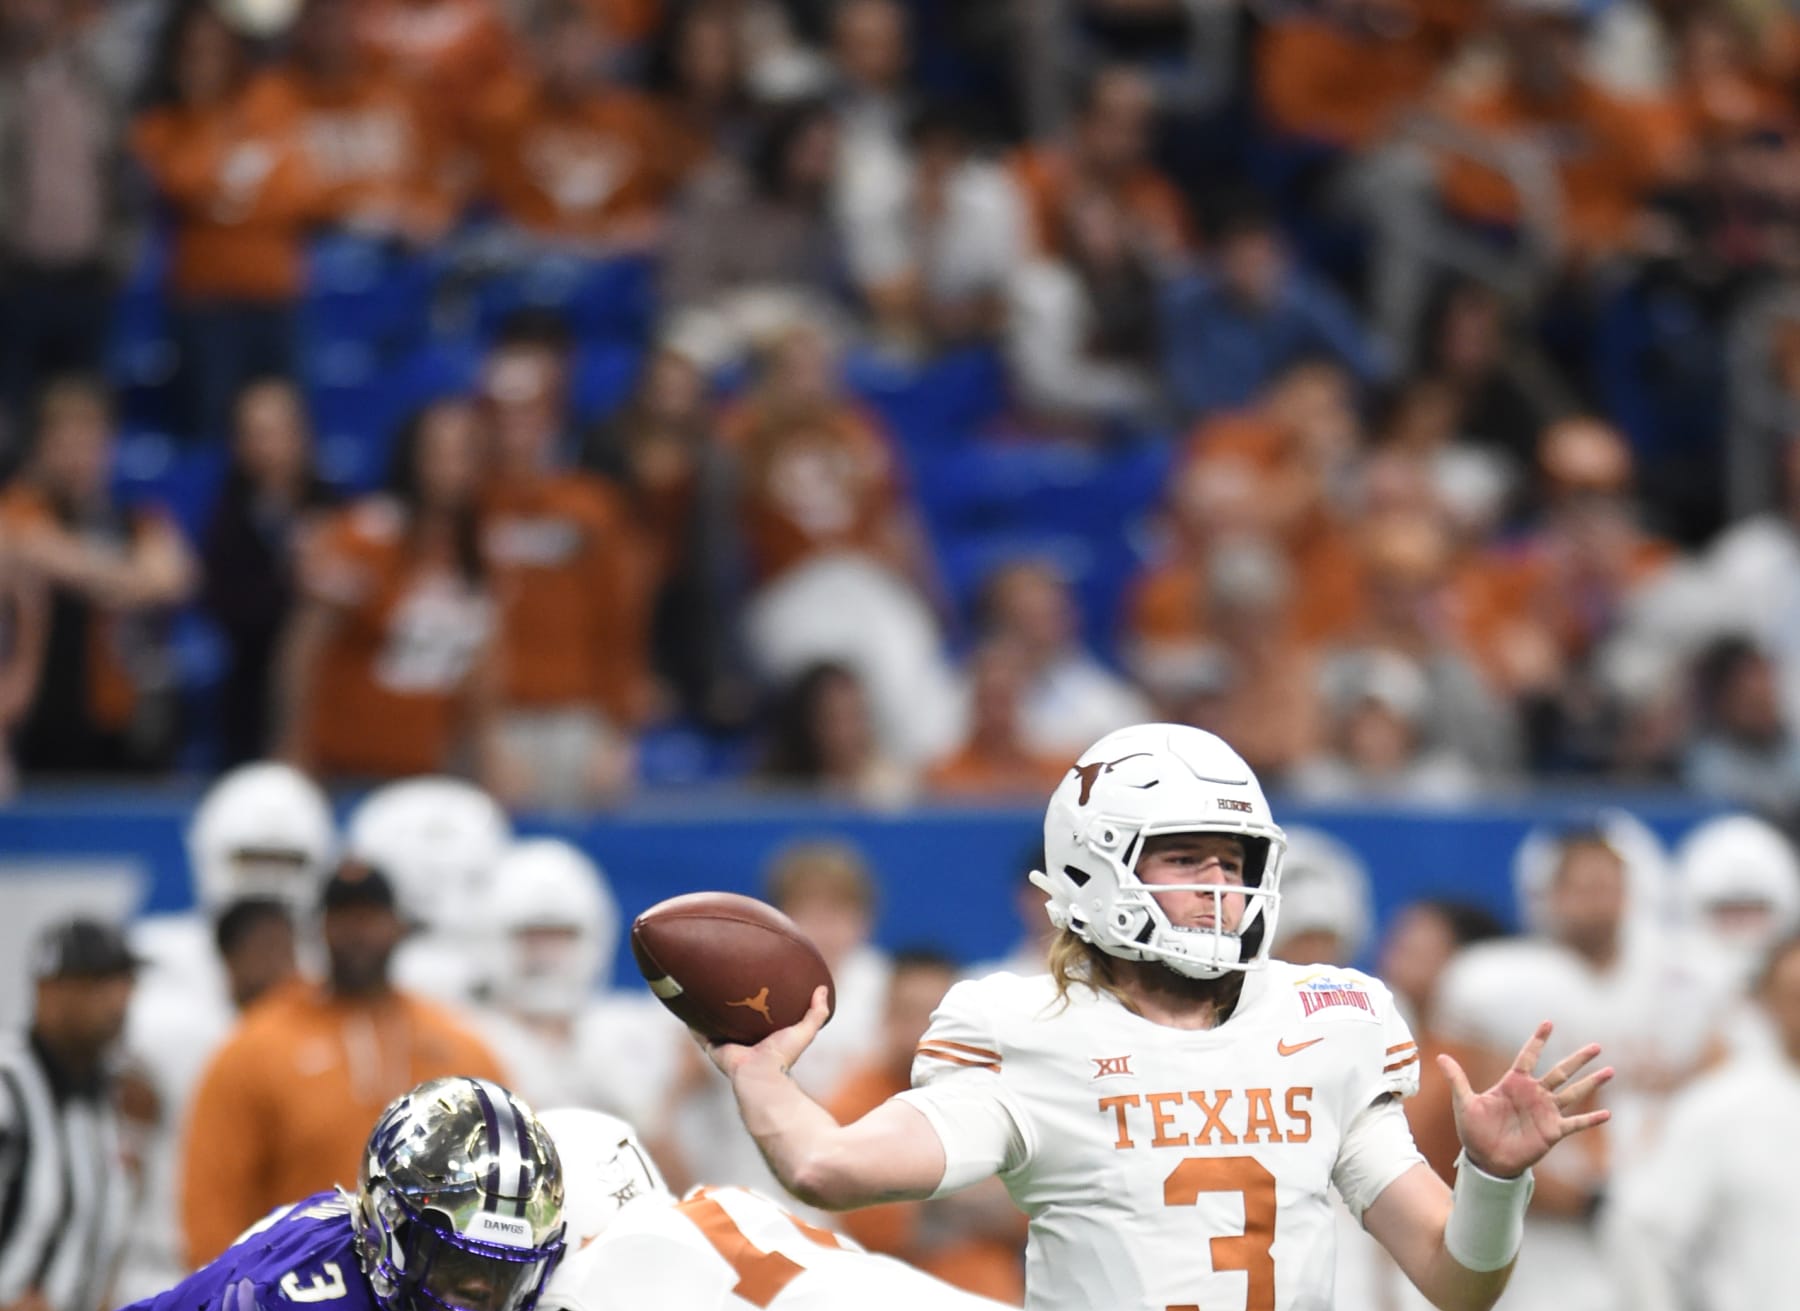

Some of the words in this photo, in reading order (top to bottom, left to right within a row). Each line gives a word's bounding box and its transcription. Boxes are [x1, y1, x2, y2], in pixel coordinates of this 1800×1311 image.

[1217, 798, 1253, 814] HORNS
[1091, 1054, 1134, 1079] XII
[1098, 1086, 1313, 1150] TEXAS
[484, 1219, 525, 1235] DAWGS
[280, 1262, 347, 1303] 3
